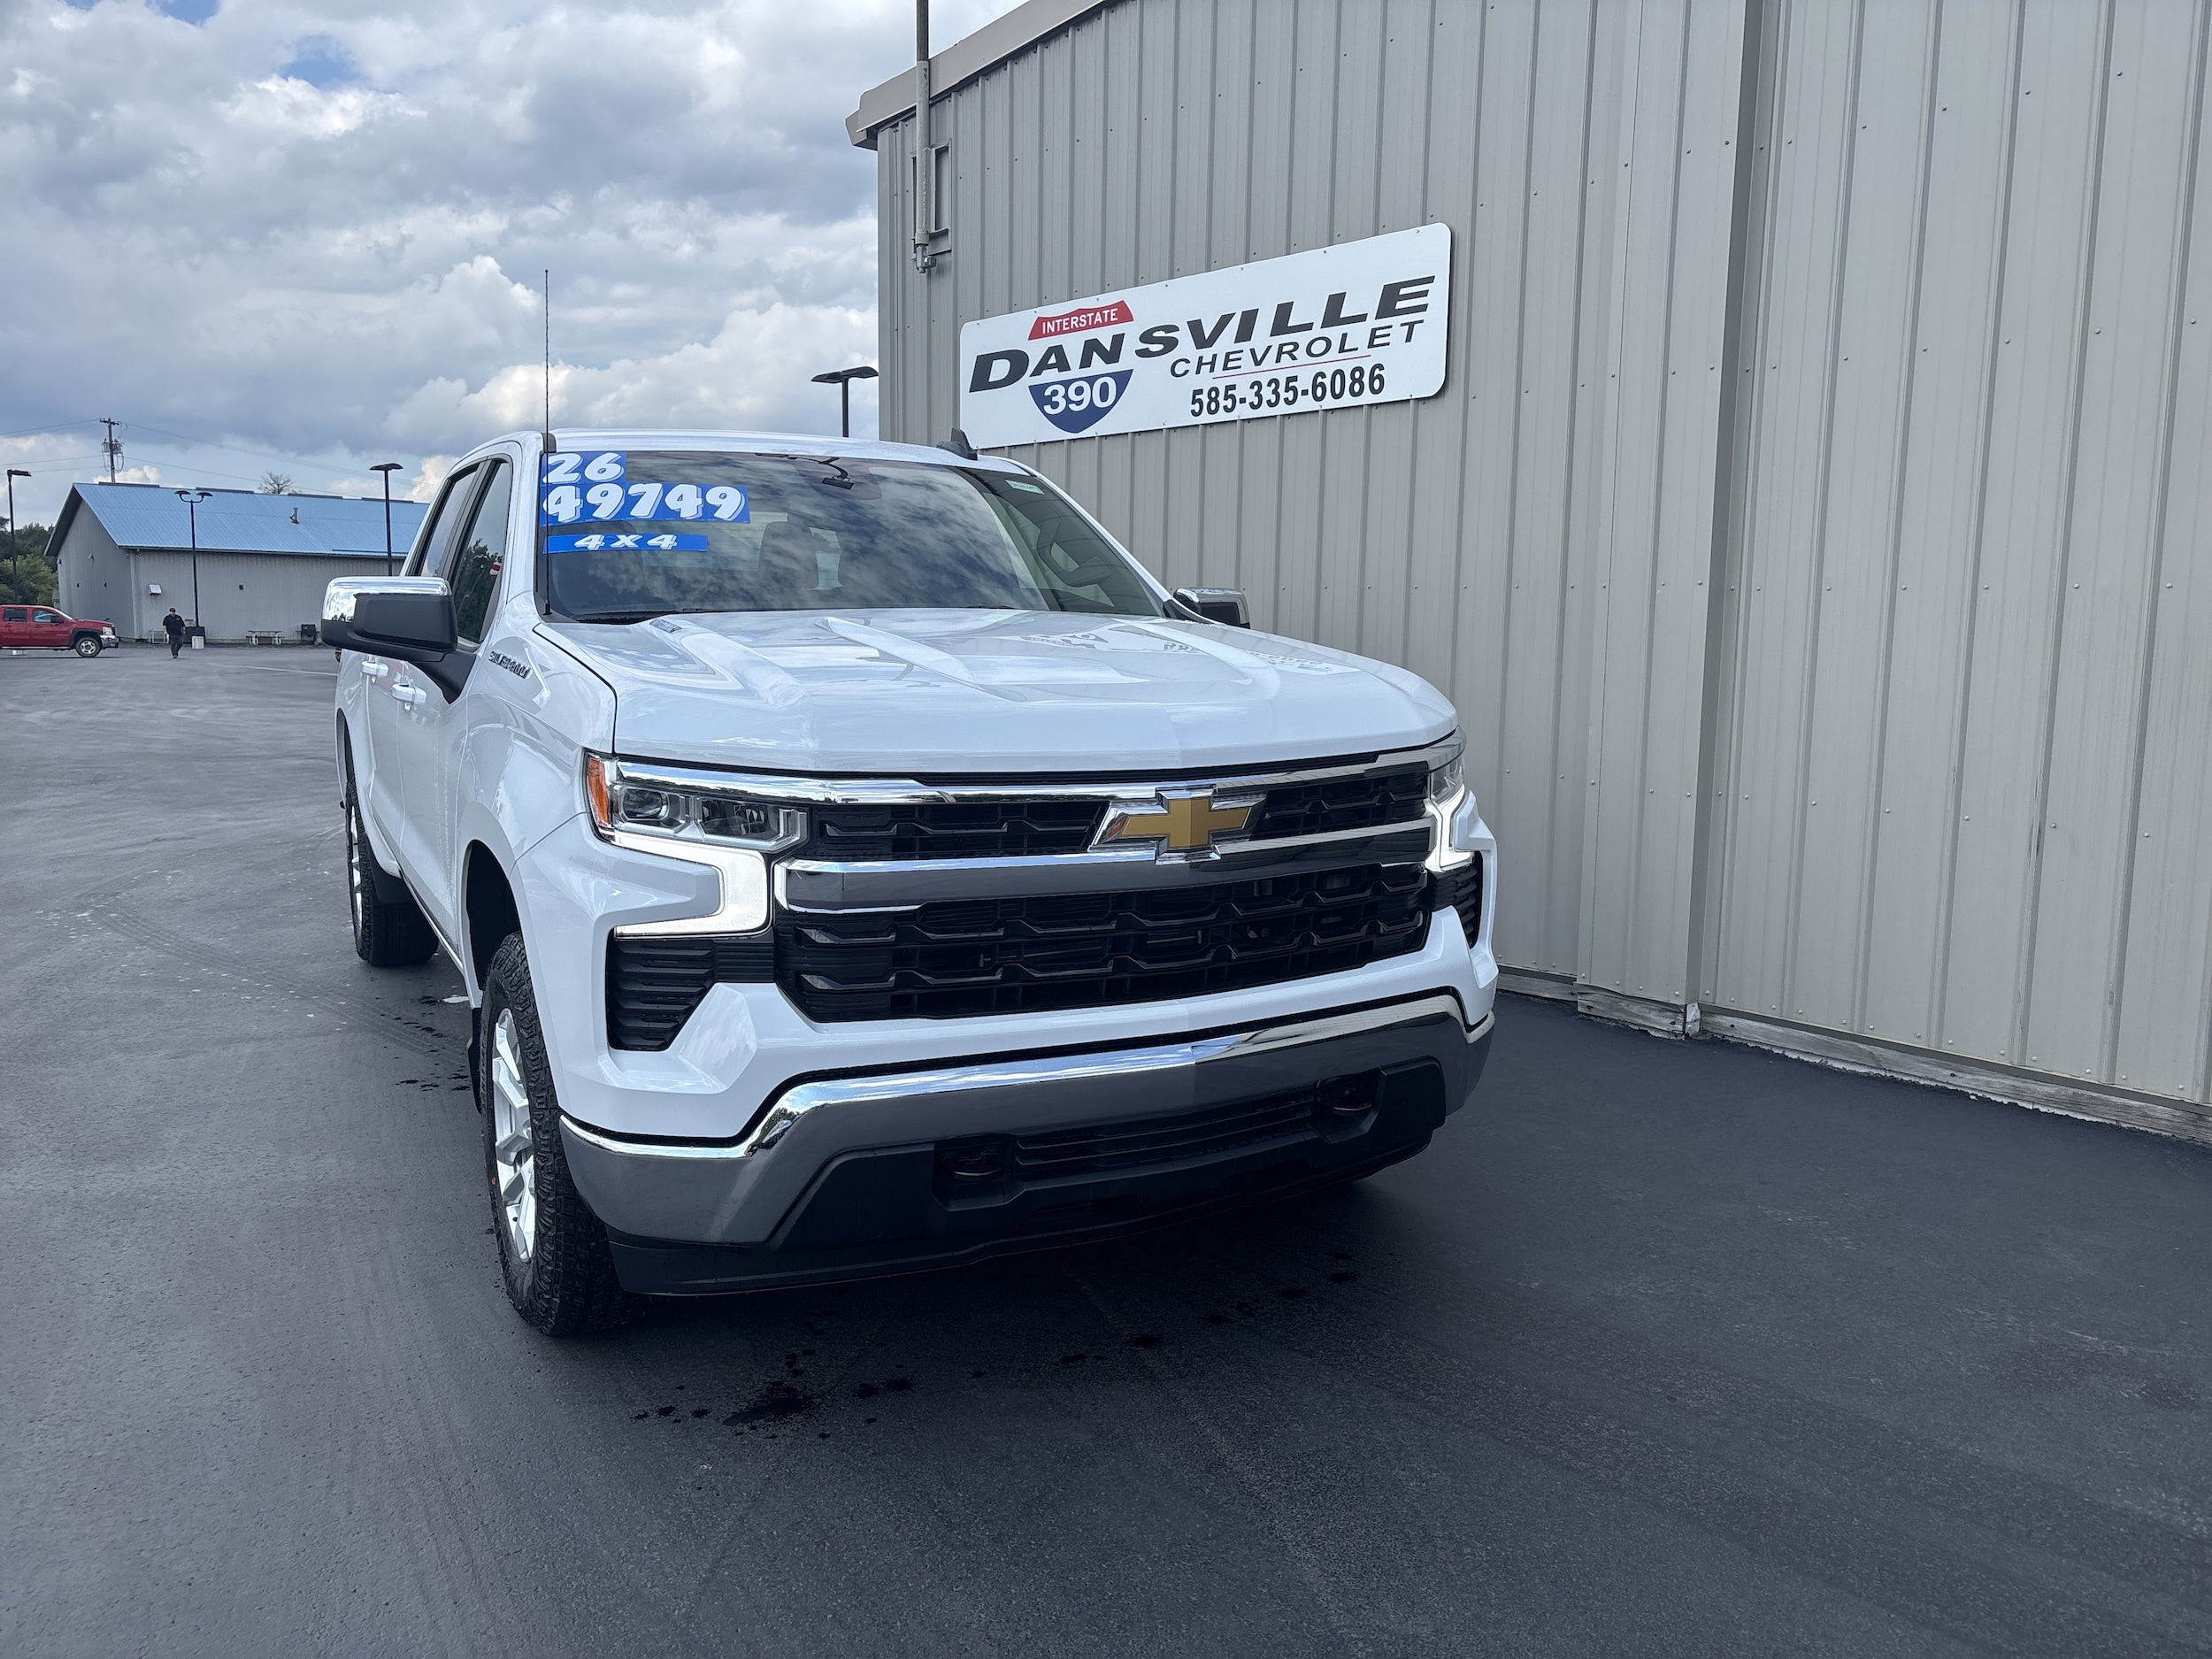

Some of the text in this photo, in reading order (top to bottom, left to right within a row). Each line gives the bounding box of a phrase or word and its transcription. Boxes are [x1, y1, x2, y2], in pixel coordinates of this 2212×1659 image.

[969, 275, 1436, 392] DANSVILLE
[1041, 307, 1119, 335] INTERSTATE
[1170, 319, 1425, 378] CHEVROLET
[1042, 375, 1118, 415] 390
[1190, 363, 1386, 417] 585-335-6086
[541, 452, 625, 484] 26
[542, 483, 746, 522] 49749
